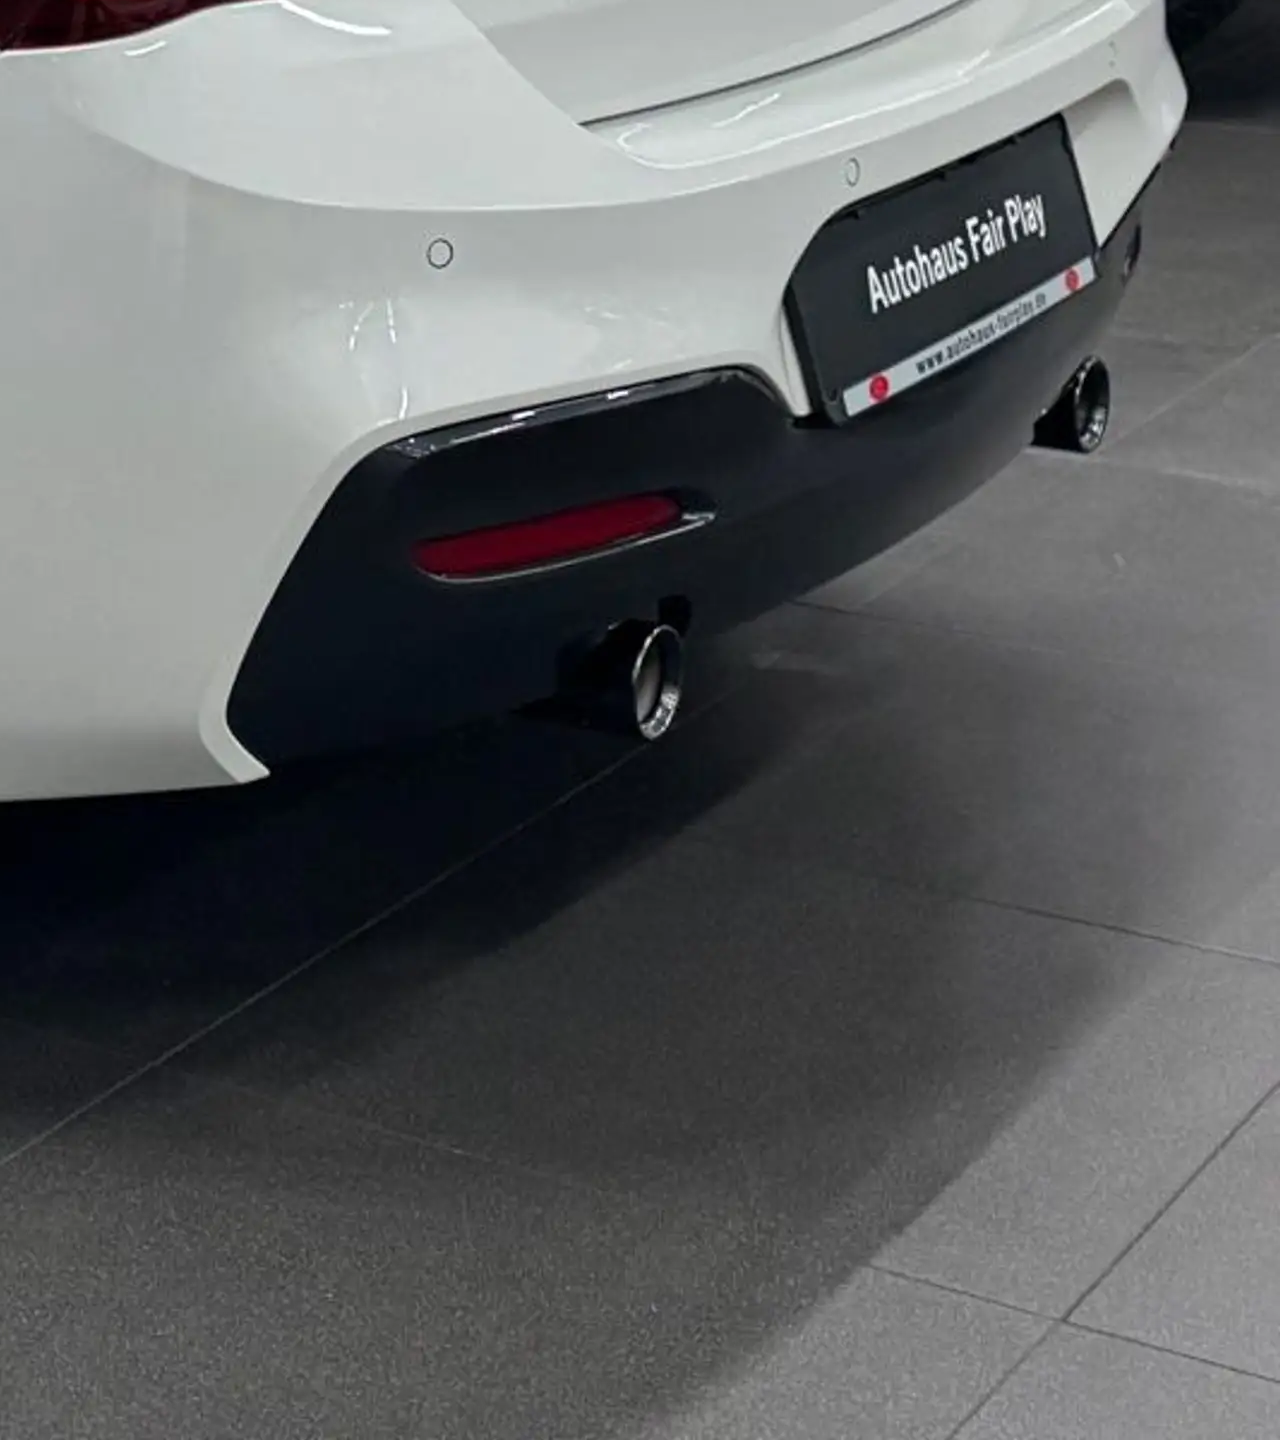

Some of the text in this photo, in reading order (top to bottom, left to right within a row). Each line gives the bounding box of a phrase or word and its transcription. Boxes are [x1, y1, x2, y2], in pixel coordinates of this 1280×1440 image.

[866, 194, 1047, 313] Autohaus Fair Play
